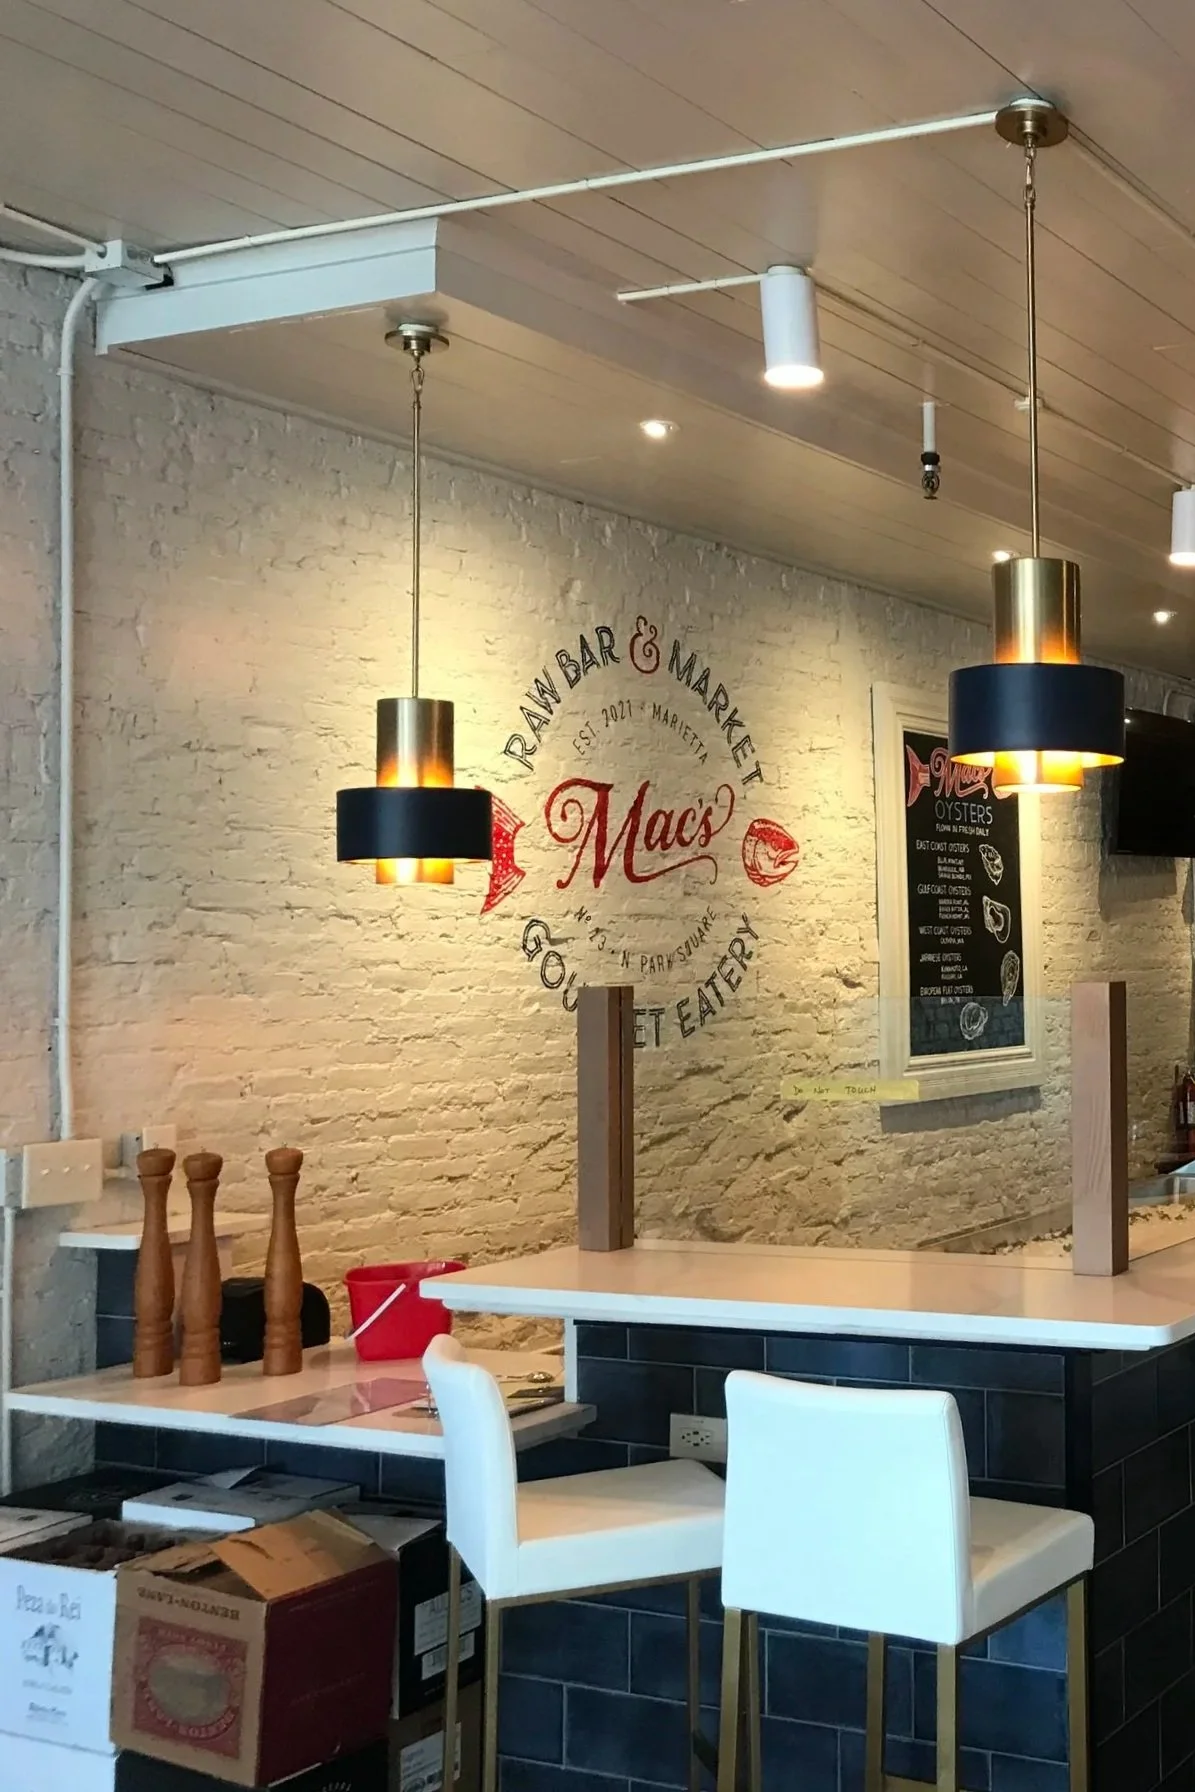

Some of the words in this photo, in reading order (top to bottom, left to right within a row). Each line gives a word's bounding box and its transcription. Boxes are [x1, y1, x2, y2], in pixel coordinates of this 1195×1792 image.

[504, 665, 561, 771] RAW
[555, 626, 620, 690] BAR
[629, 615, 660, 674] &
[668, 639, 764, 786] MARKET
[602, 699, 633, 728] 2021
[652, 702, 708, 766] MARIETTA
[934, 799, 993, 825] OYSTERS
[544, 778, 735, 889] Mac's
[958, 826, 975, 836] FRESH
[915, 839, 930, 850] EAST
[930, 841, 948, 852] COAST
[948, 842, 970, 854] OYSTERS
[917, 883, 931, 895] GULF
[930, 884, 947, 895] COAST
[948, 885, 972, 896] OYSTERS
[640, 953, 674, 974] PARK
[676, 905, 717, 962] SQUARE
[918, 925, 933, 936] WEST
[933, 926, 949, 936] COAST
[950, 926, 972, 936] OYSTERS
[676, 912, 759, 1039] EATERY
[942, 985, 954, 995] FLAT
[953, 985, 974, 995] OYSTERS
